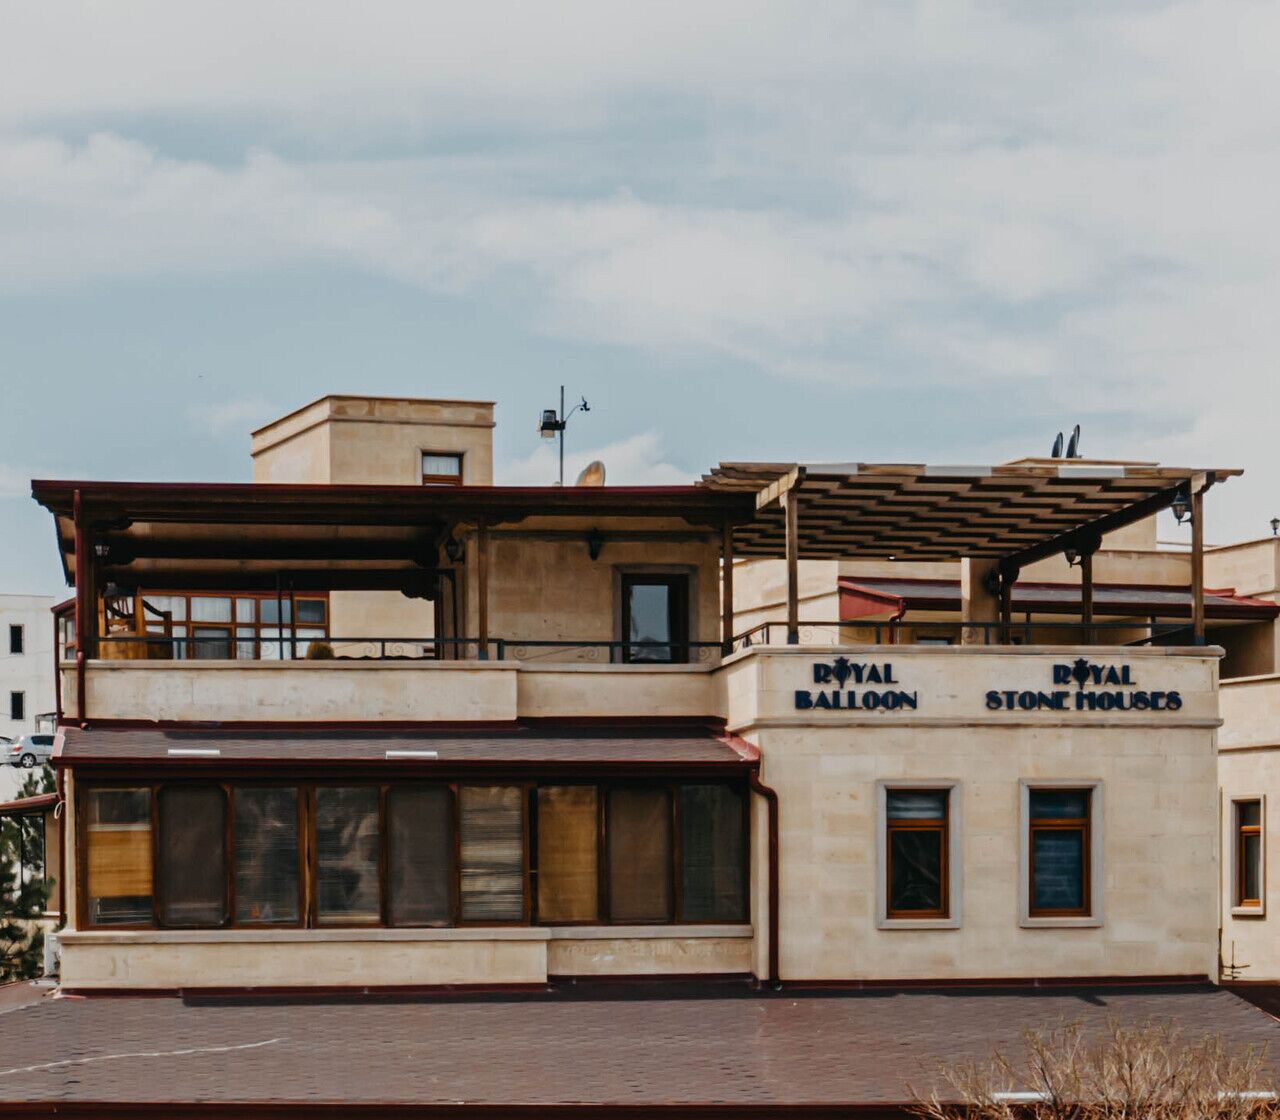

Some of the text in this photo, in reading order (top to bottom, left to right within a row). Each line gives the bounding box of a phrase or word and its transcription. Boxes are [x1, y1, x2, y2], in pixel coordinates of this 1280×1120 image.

[813, 656, 899, 689] ROYAL
[1053, 658, 1136, 690] ROYAL
[795, 690, 918, 710] BALLOON
[986, 690, 1183, 711] STONE HOUSES
